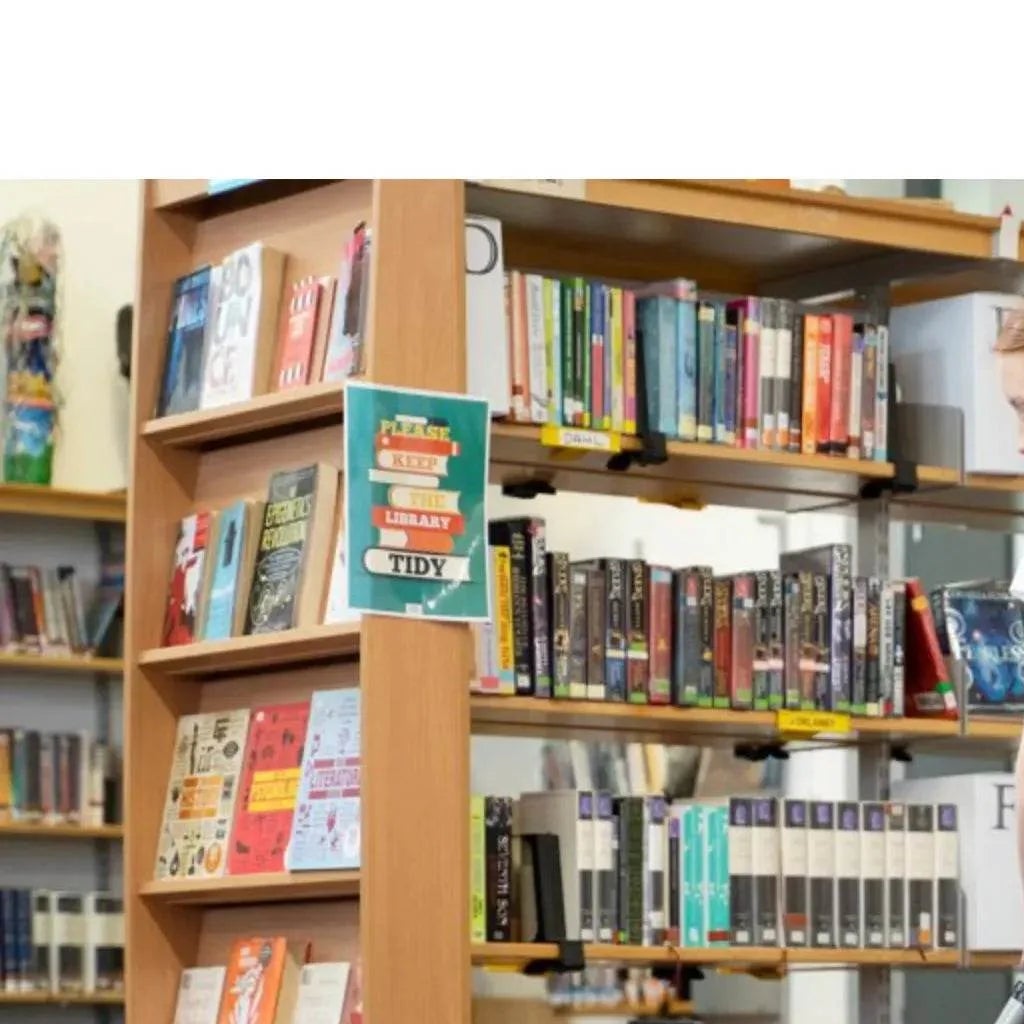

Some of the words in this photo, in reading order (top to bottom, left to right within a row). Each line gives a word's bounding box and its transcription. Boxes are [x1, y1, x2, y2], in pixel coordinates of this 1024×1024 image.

[380, 419, 451, 441] PLEASE
[391, 453, 439, 471] KEEP
[409, 490, 446, 507] THE
[385, 511, 452, 530] LIBRARY
[388, 552, 447, 577] TIDY
